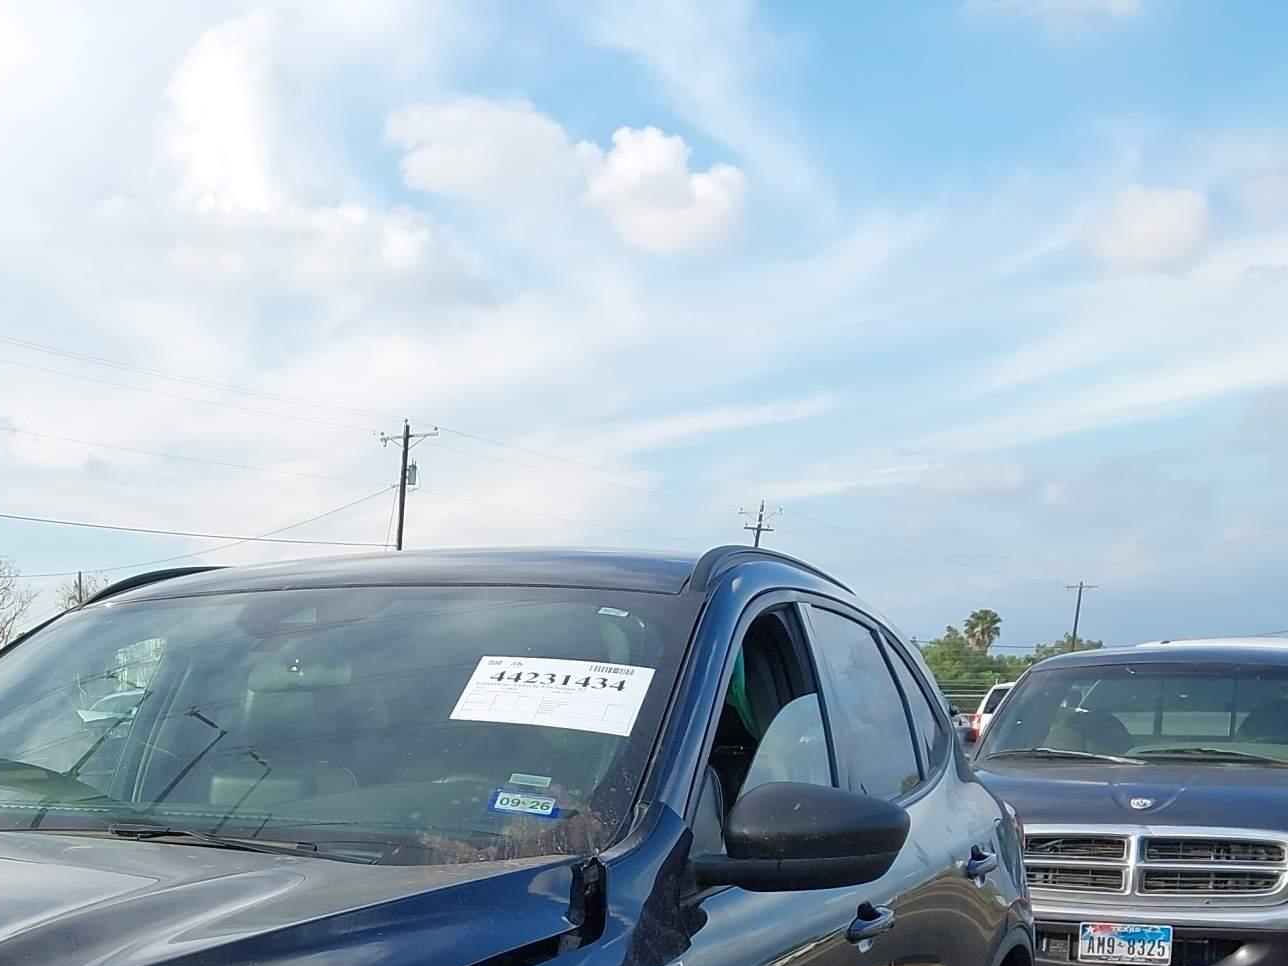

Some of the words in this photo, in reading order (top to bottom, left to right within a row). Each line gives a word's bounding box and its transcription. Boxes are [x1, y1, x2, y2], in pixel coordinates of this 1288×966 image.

[489, 670, 626, 692] 44231434
[499, 797, 521, 808] 09
[529, 800, 552, 811] 26
[1127, 938, 1165, 957] 8325
